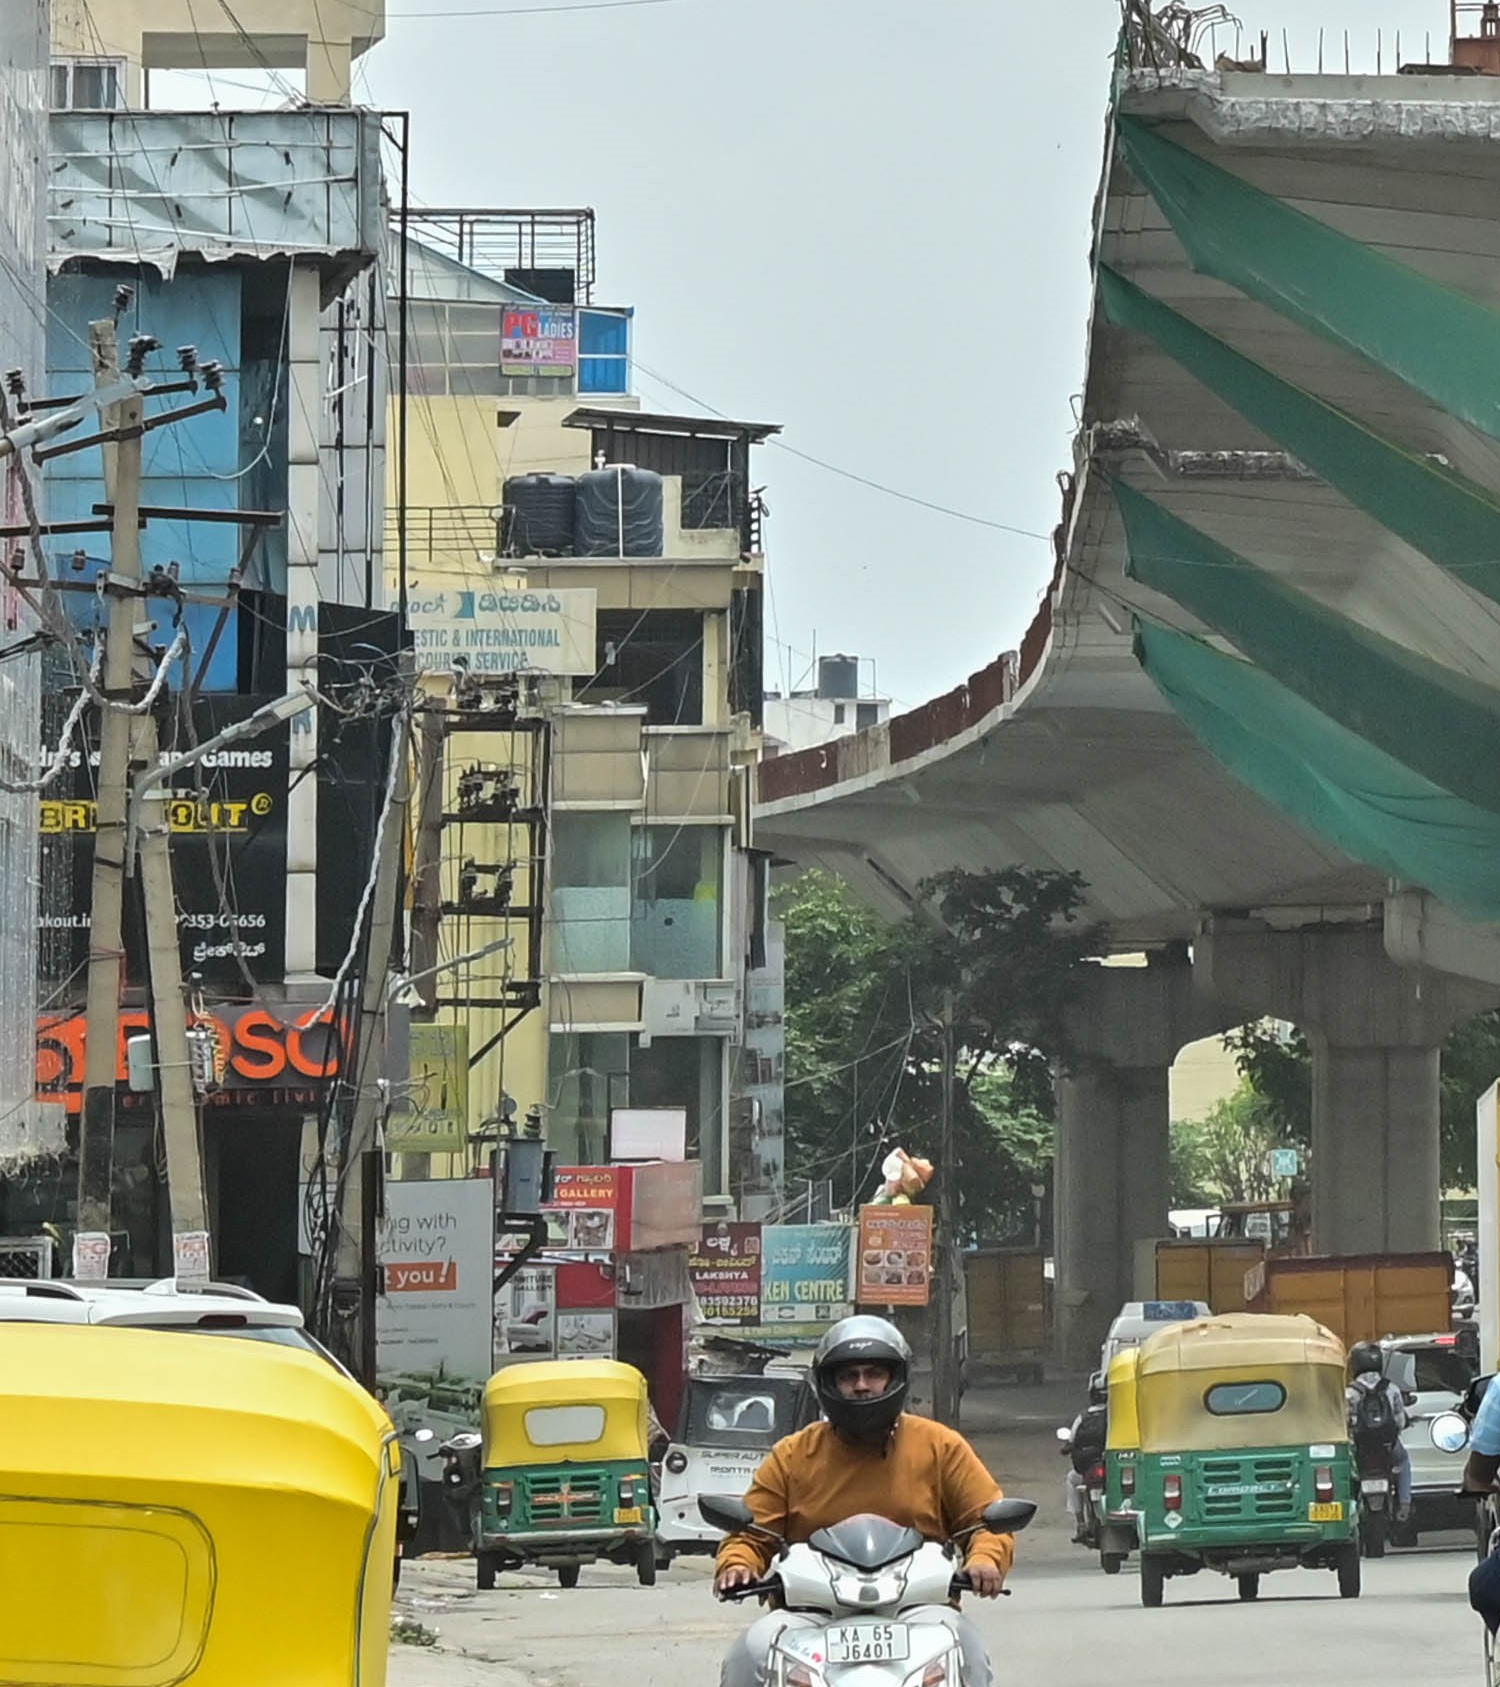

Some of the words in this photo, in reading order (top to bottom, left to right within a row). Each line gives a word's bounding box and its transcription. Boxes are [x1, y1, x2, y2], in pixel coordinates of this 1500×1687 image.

[538, 322, 573, 339] LADIES
[415, 629, 449, 648] ESTIC
[451, 629, 462, 647] &
[465, 628, 560, 647] INTERNATIONAL
[200, 750, 272, 768] Games
[559, 1188, 614, 1199] GALLERY
[416, 1212, 457, 1230] with
[695, 1271, 749, 1281] LAKSHYA
[793, 1279, 844, 1302] CENTRE
[840, 1626, 861, 1643] KA
[873, 1624, 893, 1642] 65
[841, 1641, 894, 1661] J6401
